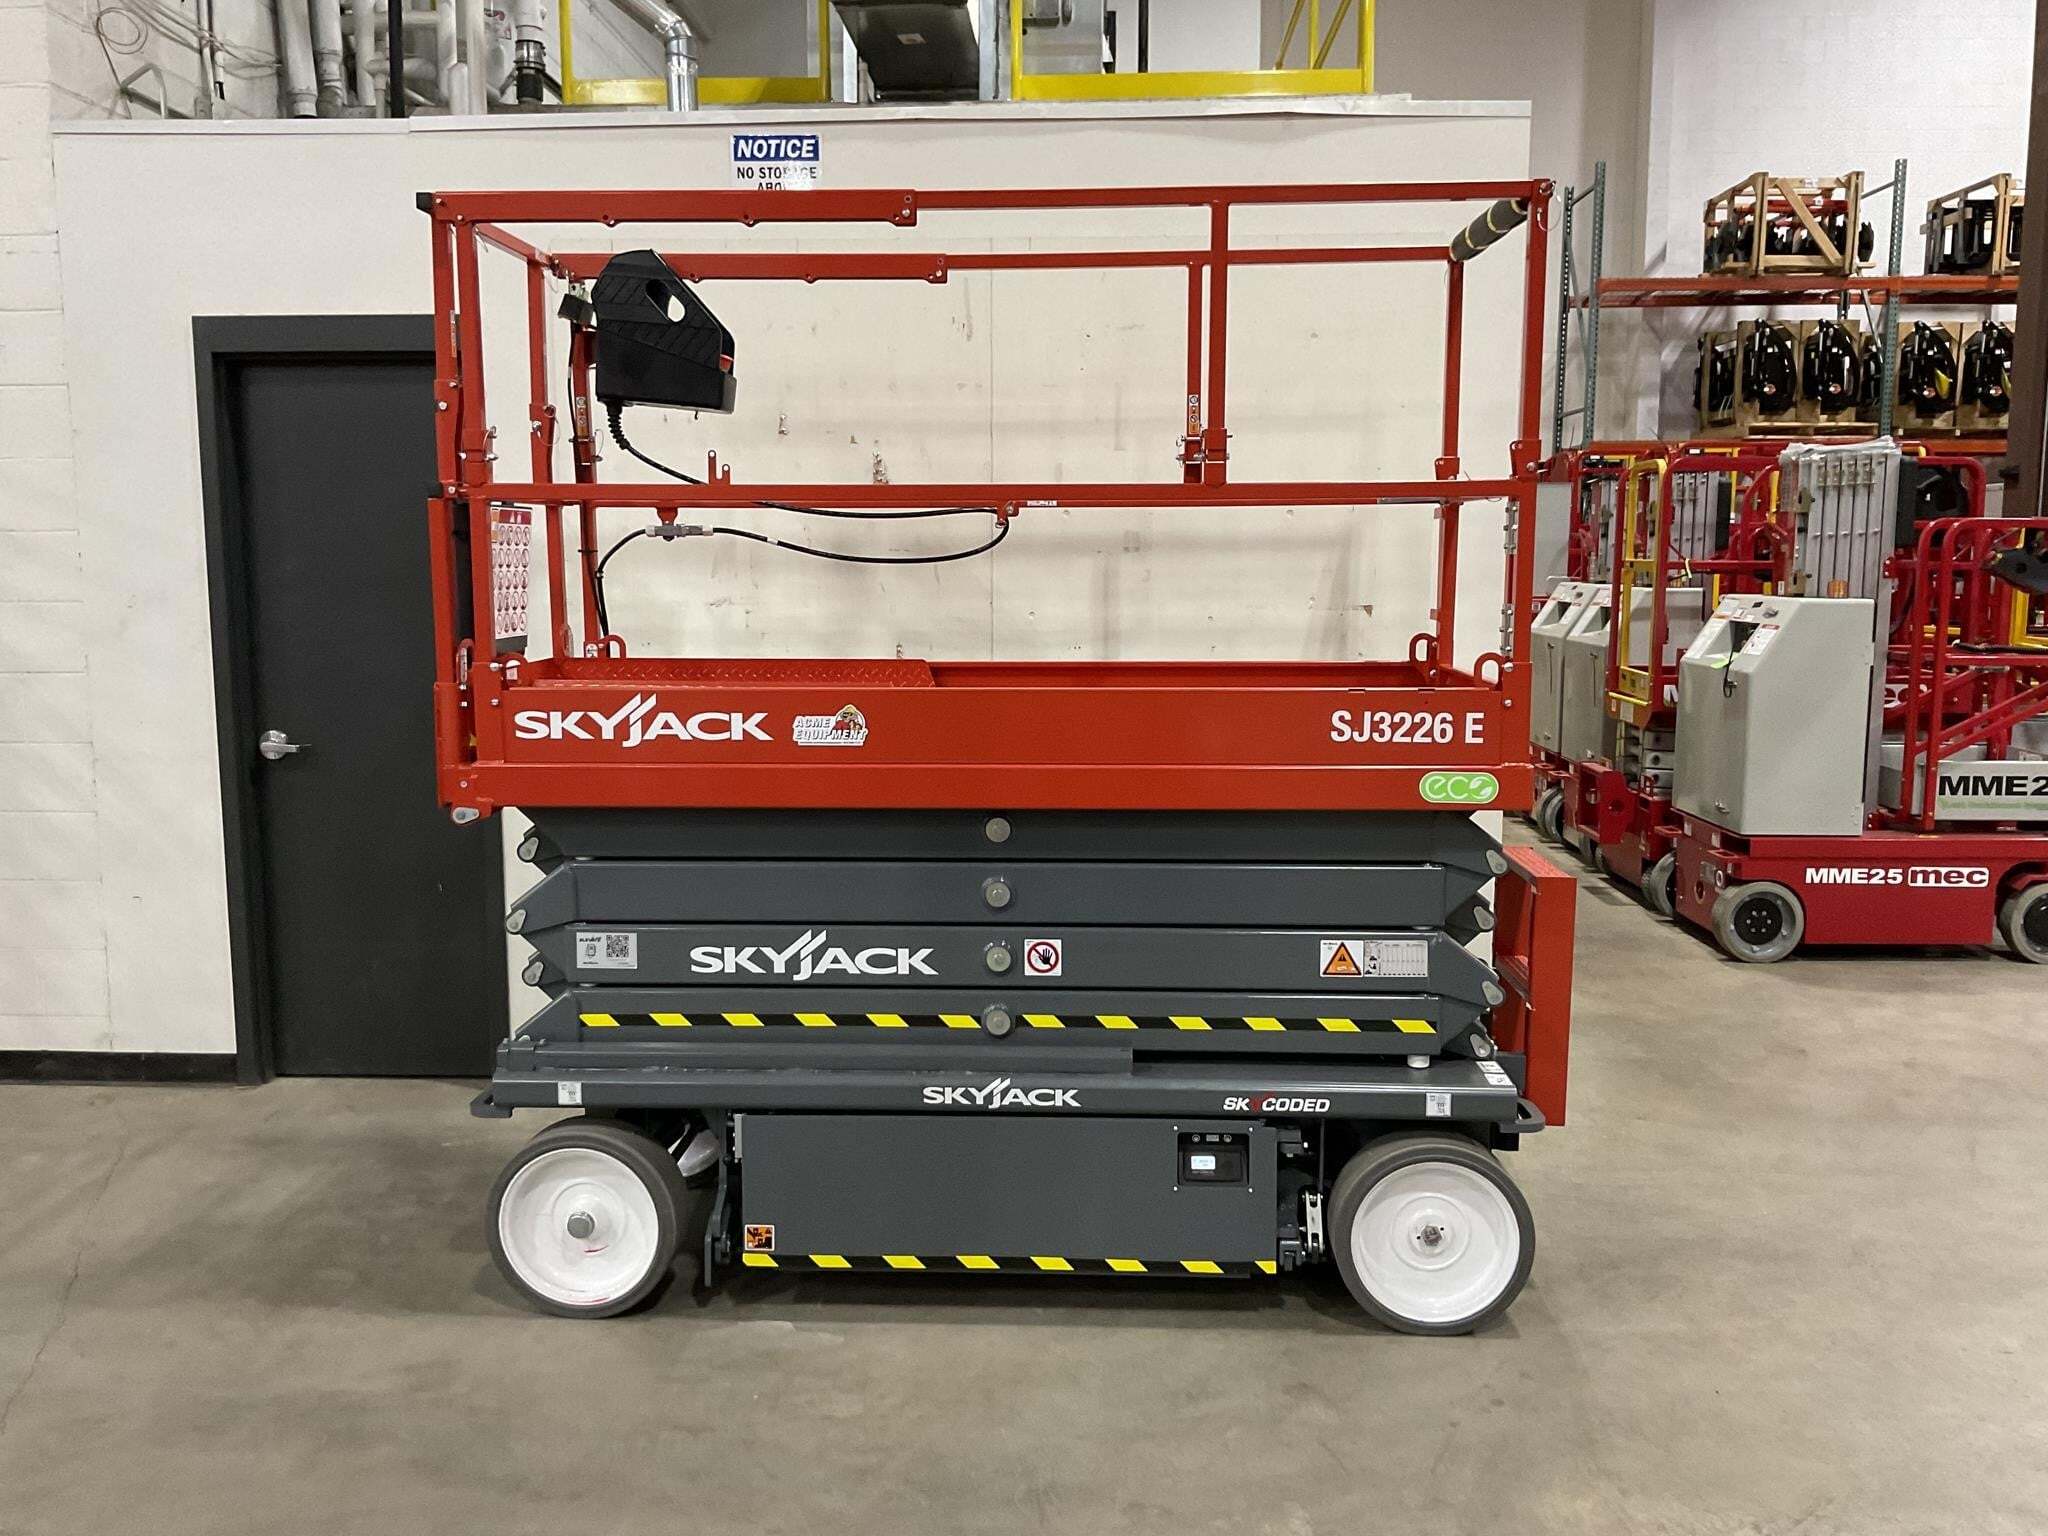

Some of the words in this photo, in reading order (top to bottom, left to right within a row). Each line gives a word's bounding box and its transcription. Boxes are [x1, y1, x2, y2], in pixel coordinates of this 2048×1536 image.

[737, 139, 815, 158] NOTICE
[737, 167, 754, 179] NO
[758, 167, 817, 179] STOGE
[514, 693, 774, 748] SKYJACK
[795, 718, 832, 728] ACME
[1330, 710, 1454, 743] SJ3226
[1464, 712, 1485, 744] E
[795, 729, 867, 741] EQUIPMENT
[1805, 868, 1903, 885] MME25
[1910, 869, 1987, 884] mec
[689, 929, 939, 981] SKYJACK
[922, 1077, 1082, 1109] SKYJACK
